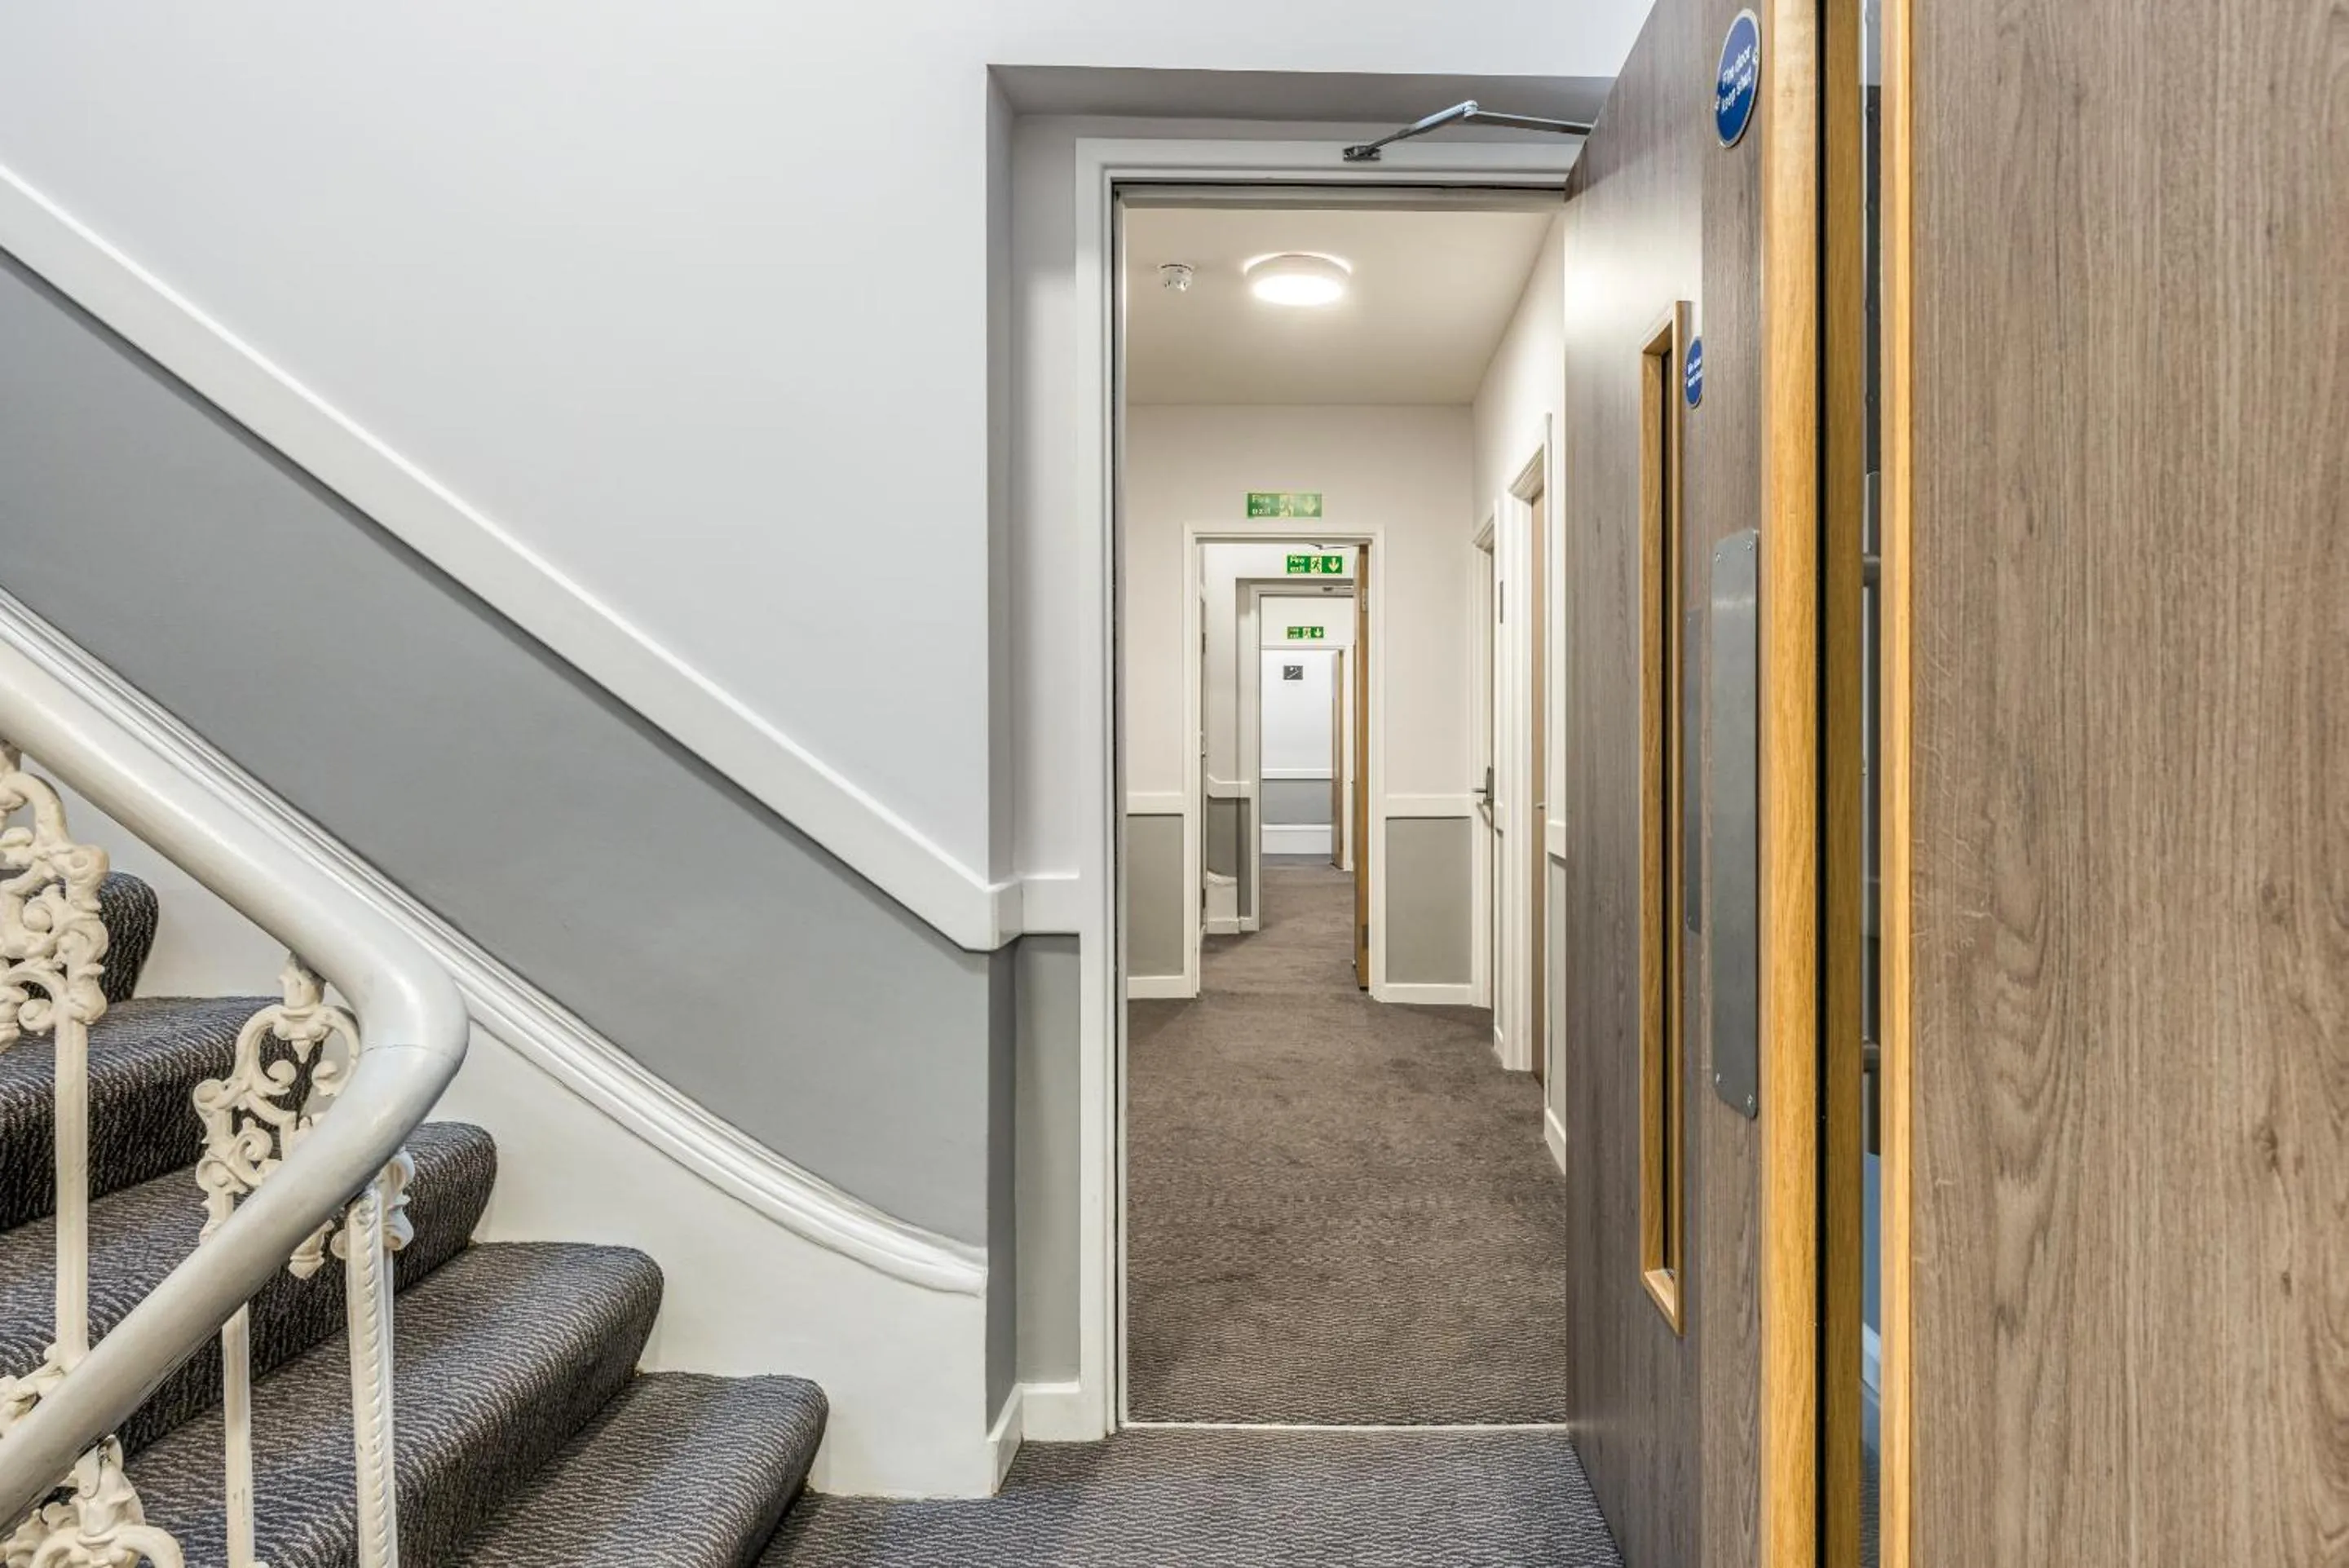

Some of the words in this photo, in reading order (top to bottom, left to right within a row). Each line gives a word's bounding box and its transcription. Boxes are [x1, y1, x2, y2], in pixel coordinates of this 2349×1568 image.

[1735, 44, 1751, 72] door
[1721, 87, 1735, 114] keep
[1737, 66, 1751, 95] shut
